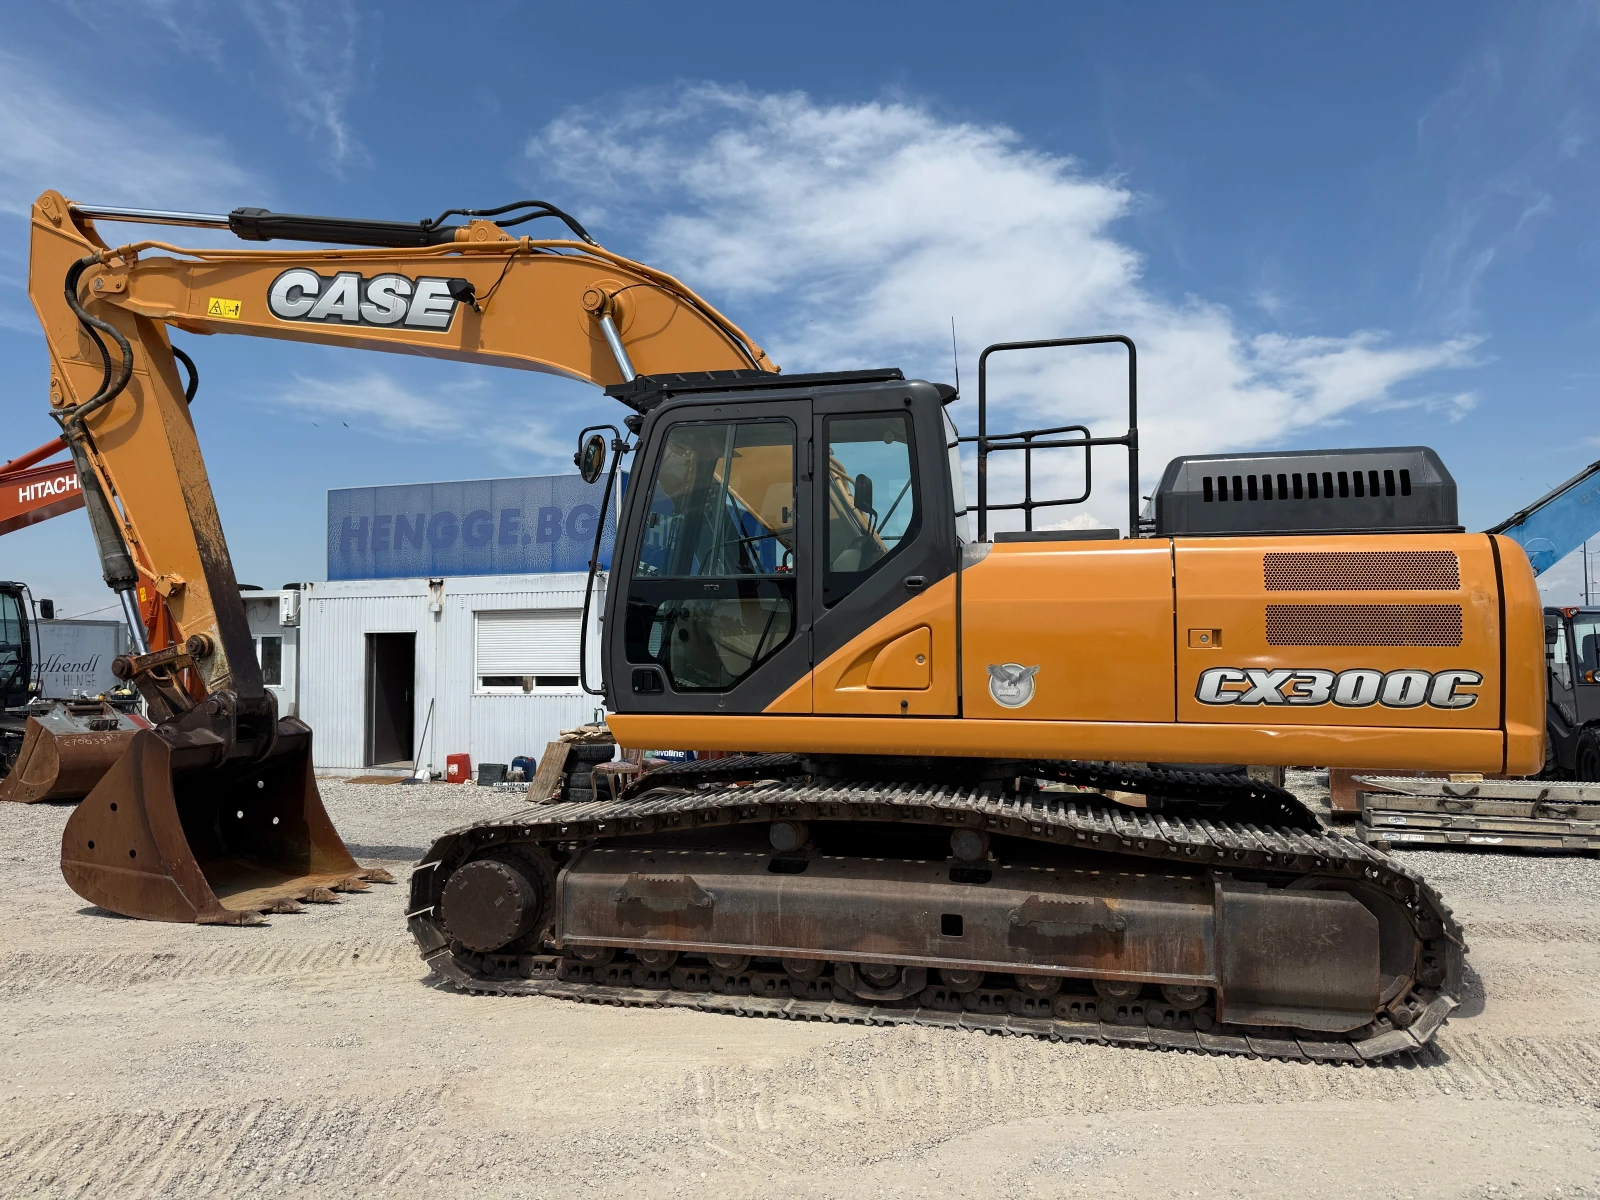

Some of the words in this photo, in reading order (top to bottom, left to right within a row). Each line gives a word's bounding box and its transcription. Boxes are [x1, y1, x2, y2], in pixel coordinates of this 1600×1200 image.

[269, 269, 458, 330] CASE
[339, 503, 600, 553] HENGGE.BG
[1195, 667, 1483, 709] CX300C
